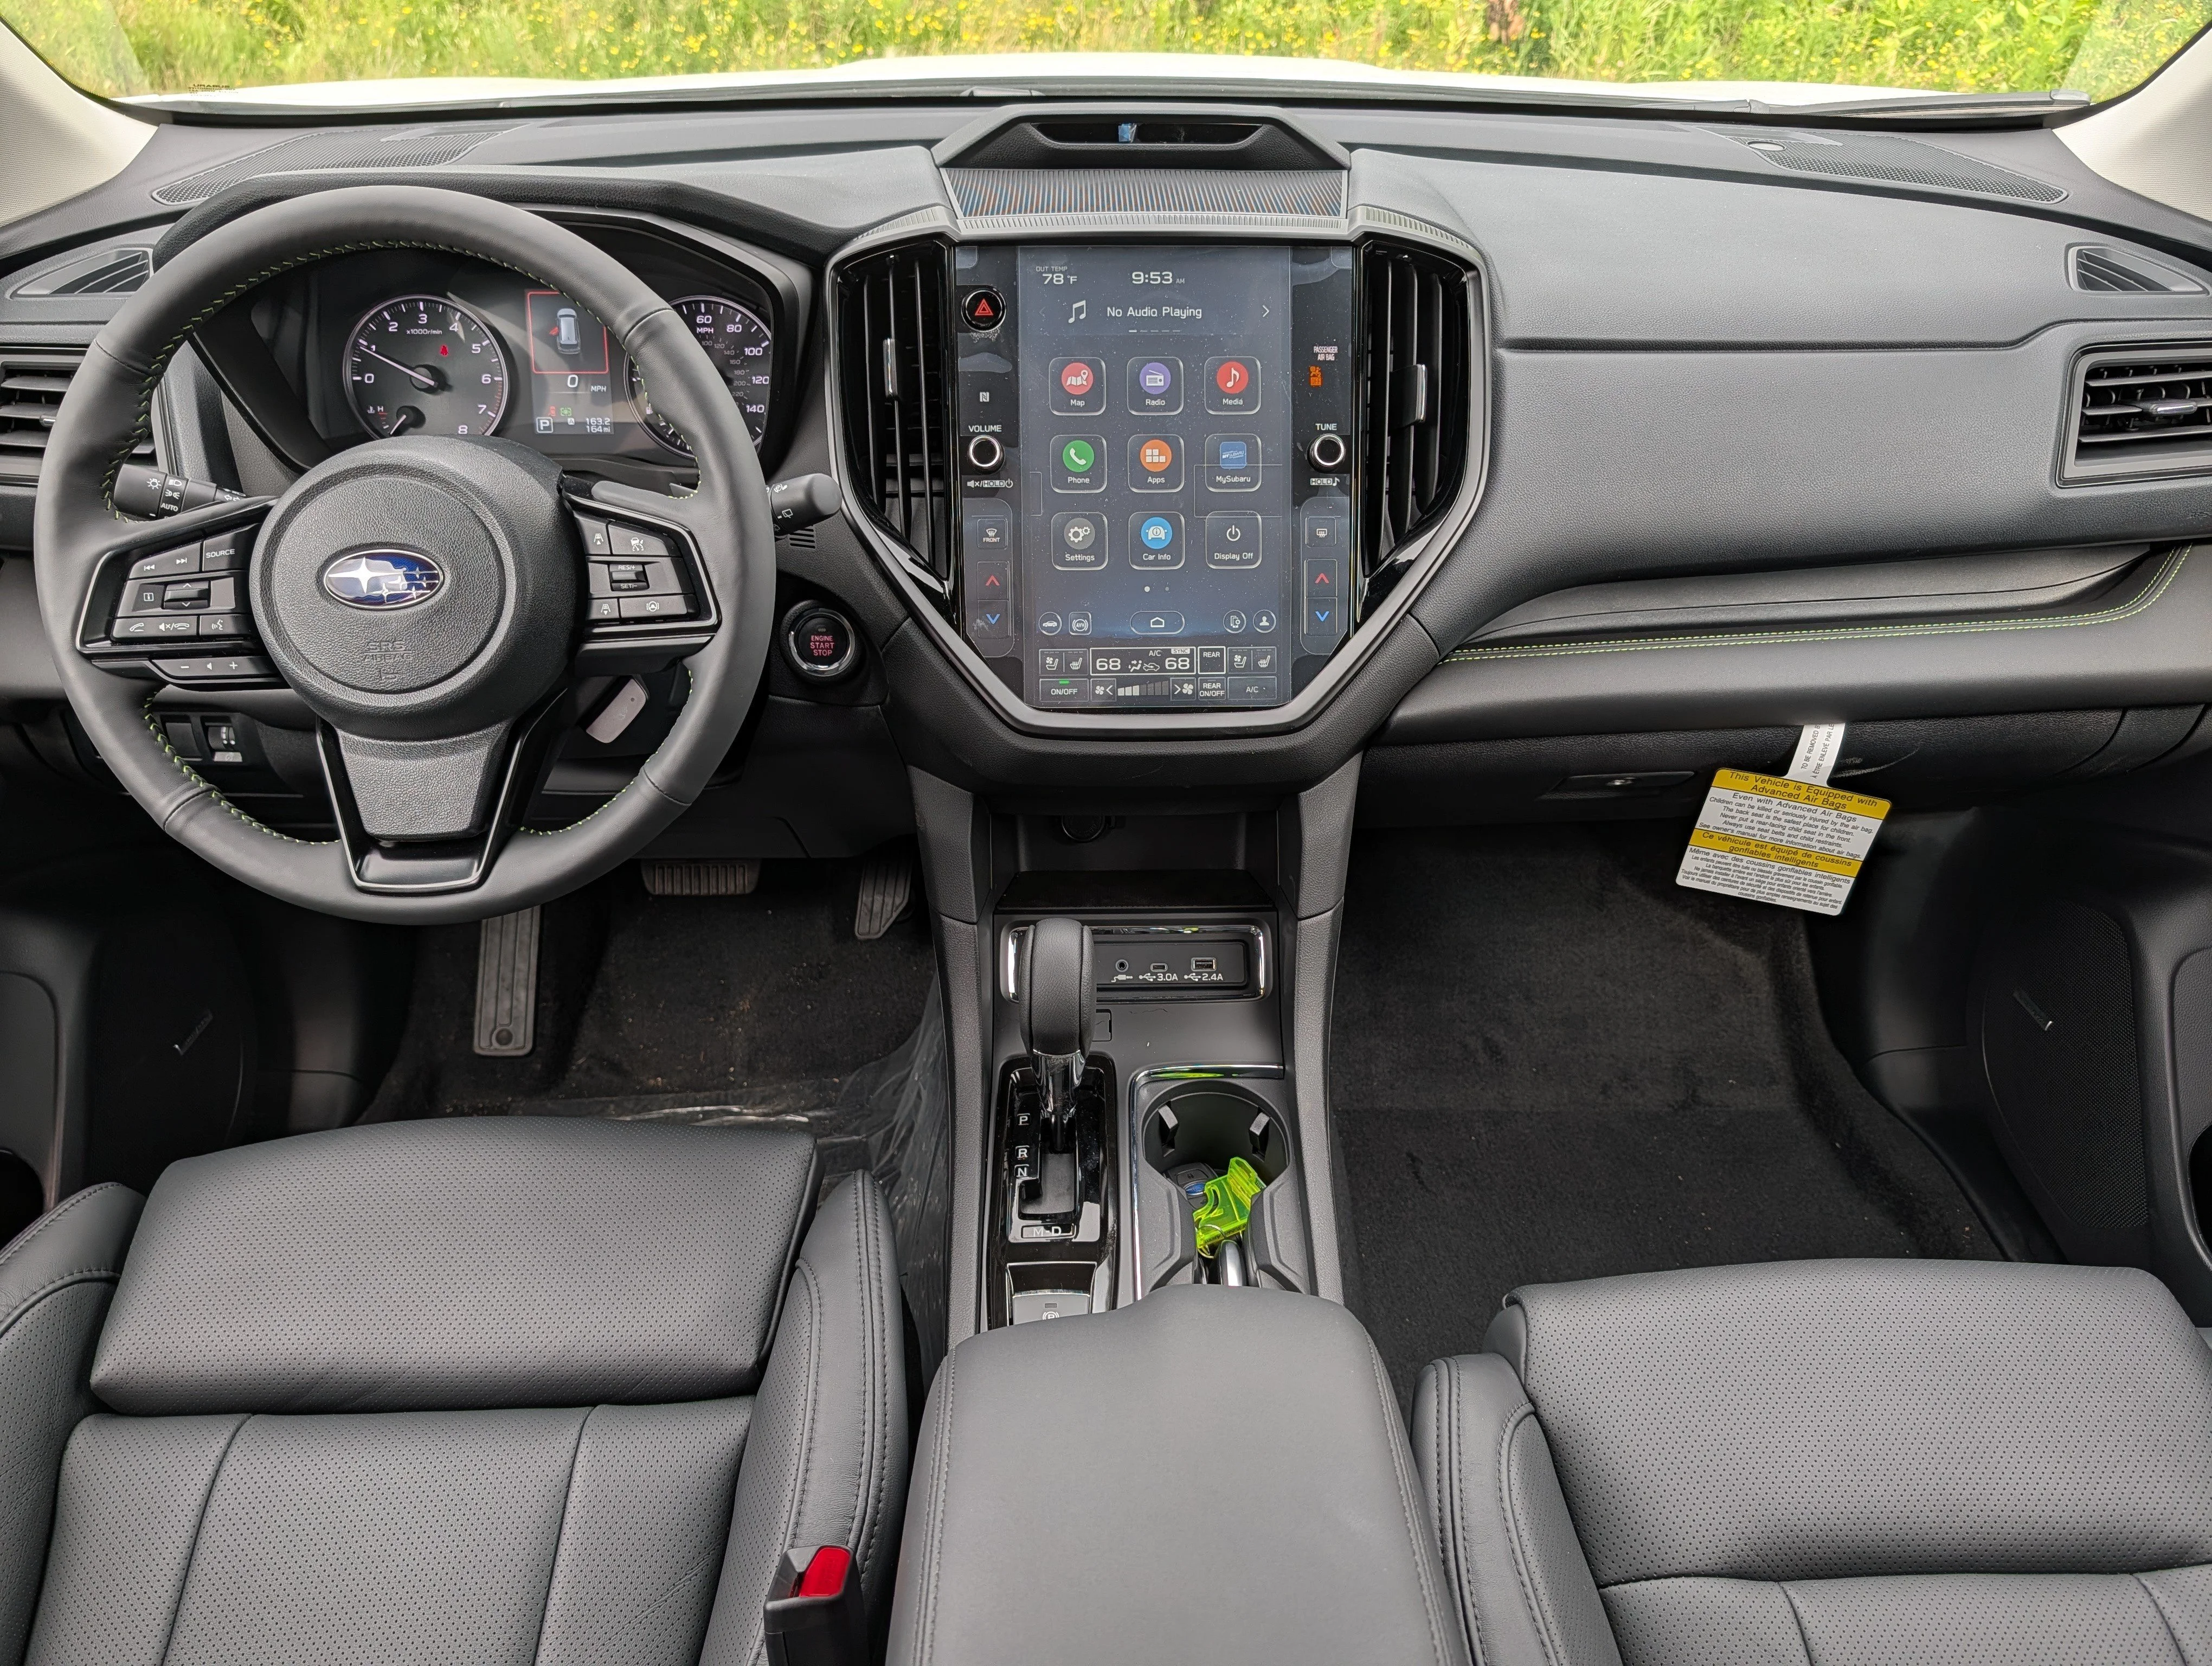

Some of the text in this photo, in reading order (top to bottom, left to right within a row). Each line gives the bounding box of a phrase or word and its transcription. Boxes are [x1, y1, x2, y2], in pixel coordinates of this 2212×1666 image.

[1042, 273, 1064, 284] 78
[1131, 272, 1173, 284] 9:53
[1107, 306, 1203, 319] No Audio Playing
[418, 313, 427, 324] 3
[696, 315, 712, 324] 60
[388, 322, 398, 332] 2
[449, 322, 459, 332] 4
[726, 324, 742, 333] 80
[471, 343, 481, 354] 5
[744, 347, 763, 356] 100
[364, 373, 375, 383] 0
[481, 374, 491, 384] 6
[567, 374, 578, 388] 0
[751, 376, 770, 385] 120
[1070, 399, 1085, 407] Map
[478, 404, 487, 414] 7
[746, 404, 765, 413] 140
[458, 425, 468, 434] 8
[539, 419, 550, 430] P
[1147, 477, 1166, 485] Apps
[160, 502, 178, 512] AUTO
[205, 549, 235, 559] SOURCE
[1065, 554, 1095, 562] Settings
[1214, 553, 1240, 561] Display
[367, 640, 406, 651] SRS
[1096, 658, 1121, 670] 68
[1165, 658, 1190, 670] 68
[1806, 730, 1819, 754] REMOVED
[1811, 762, 1823, 774] ÊTRE
[1818, 742, 1830, 761] ENLEVÉ
[1824, 731, 1832, 742] PAR
[1730, 770, 1879, 806] This Vehicle is Equipped with
[1751, 784, 1846, 809] Advanced Air Bags
[1709, 797, 1733, 805] Children
[1782, 811, 1807, 820] seriously
[1809, 816, 1829, 824] injured
[1732, 792, 1753, 801] Even
[1776, 801, 1817, 813] Advanced
[1835, 812, 1856, 822] Bags
[1785, 839, 1816, 849] information
[1718, 836, 1751, 846] véhicule
[1770, 845, 1798, 855] équipé
[1815, 855, 1851, 866] coussins
[1728, 845, 1818, 867] gonflables intelligents
[1689, 847, 1710, 856] Même
[1746, 860, 1775, 869] coussins
[1777, 866, 1812, 876] gonflables
[1815, 872, 1850, 883] intelligents
[1157, 973, 1178, 981] 3.0A
[1202, 973, 1224, 981] 2.4A
[1019, 1116, 1028, 1124] P
[1018, 1148, 1028, 1157] R
[1018, 1167, 1027, 1176] N
